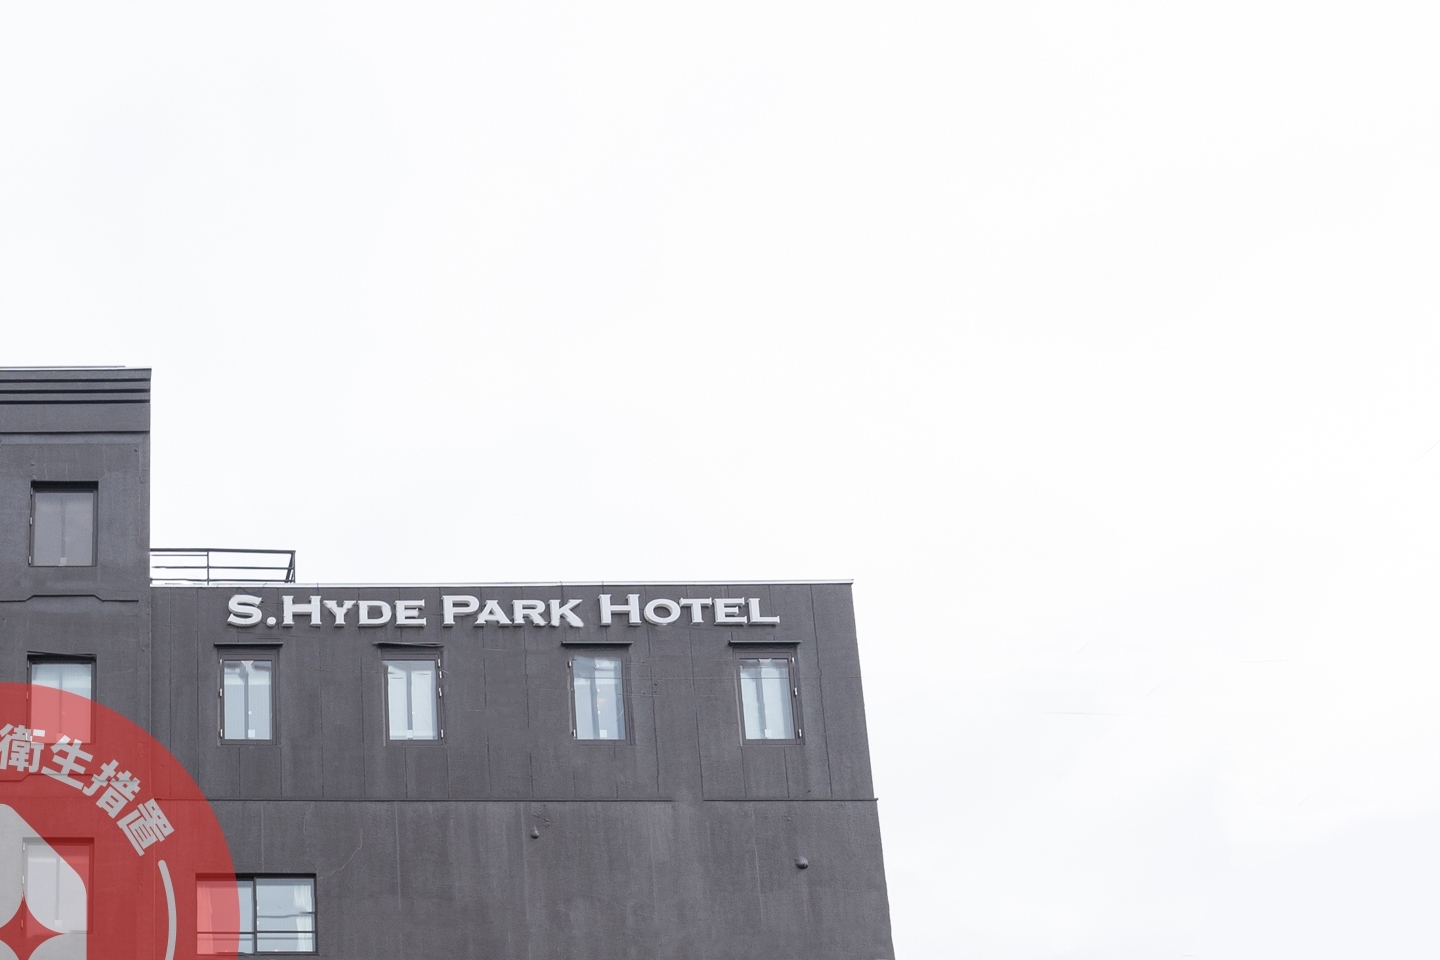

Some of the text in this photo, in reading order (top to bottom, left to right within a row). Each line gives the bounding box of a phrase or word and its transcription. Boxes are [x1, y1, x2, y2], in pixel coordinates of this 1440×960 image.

[227, 593, 780, 628] S.HYDE PARK HOTEL
